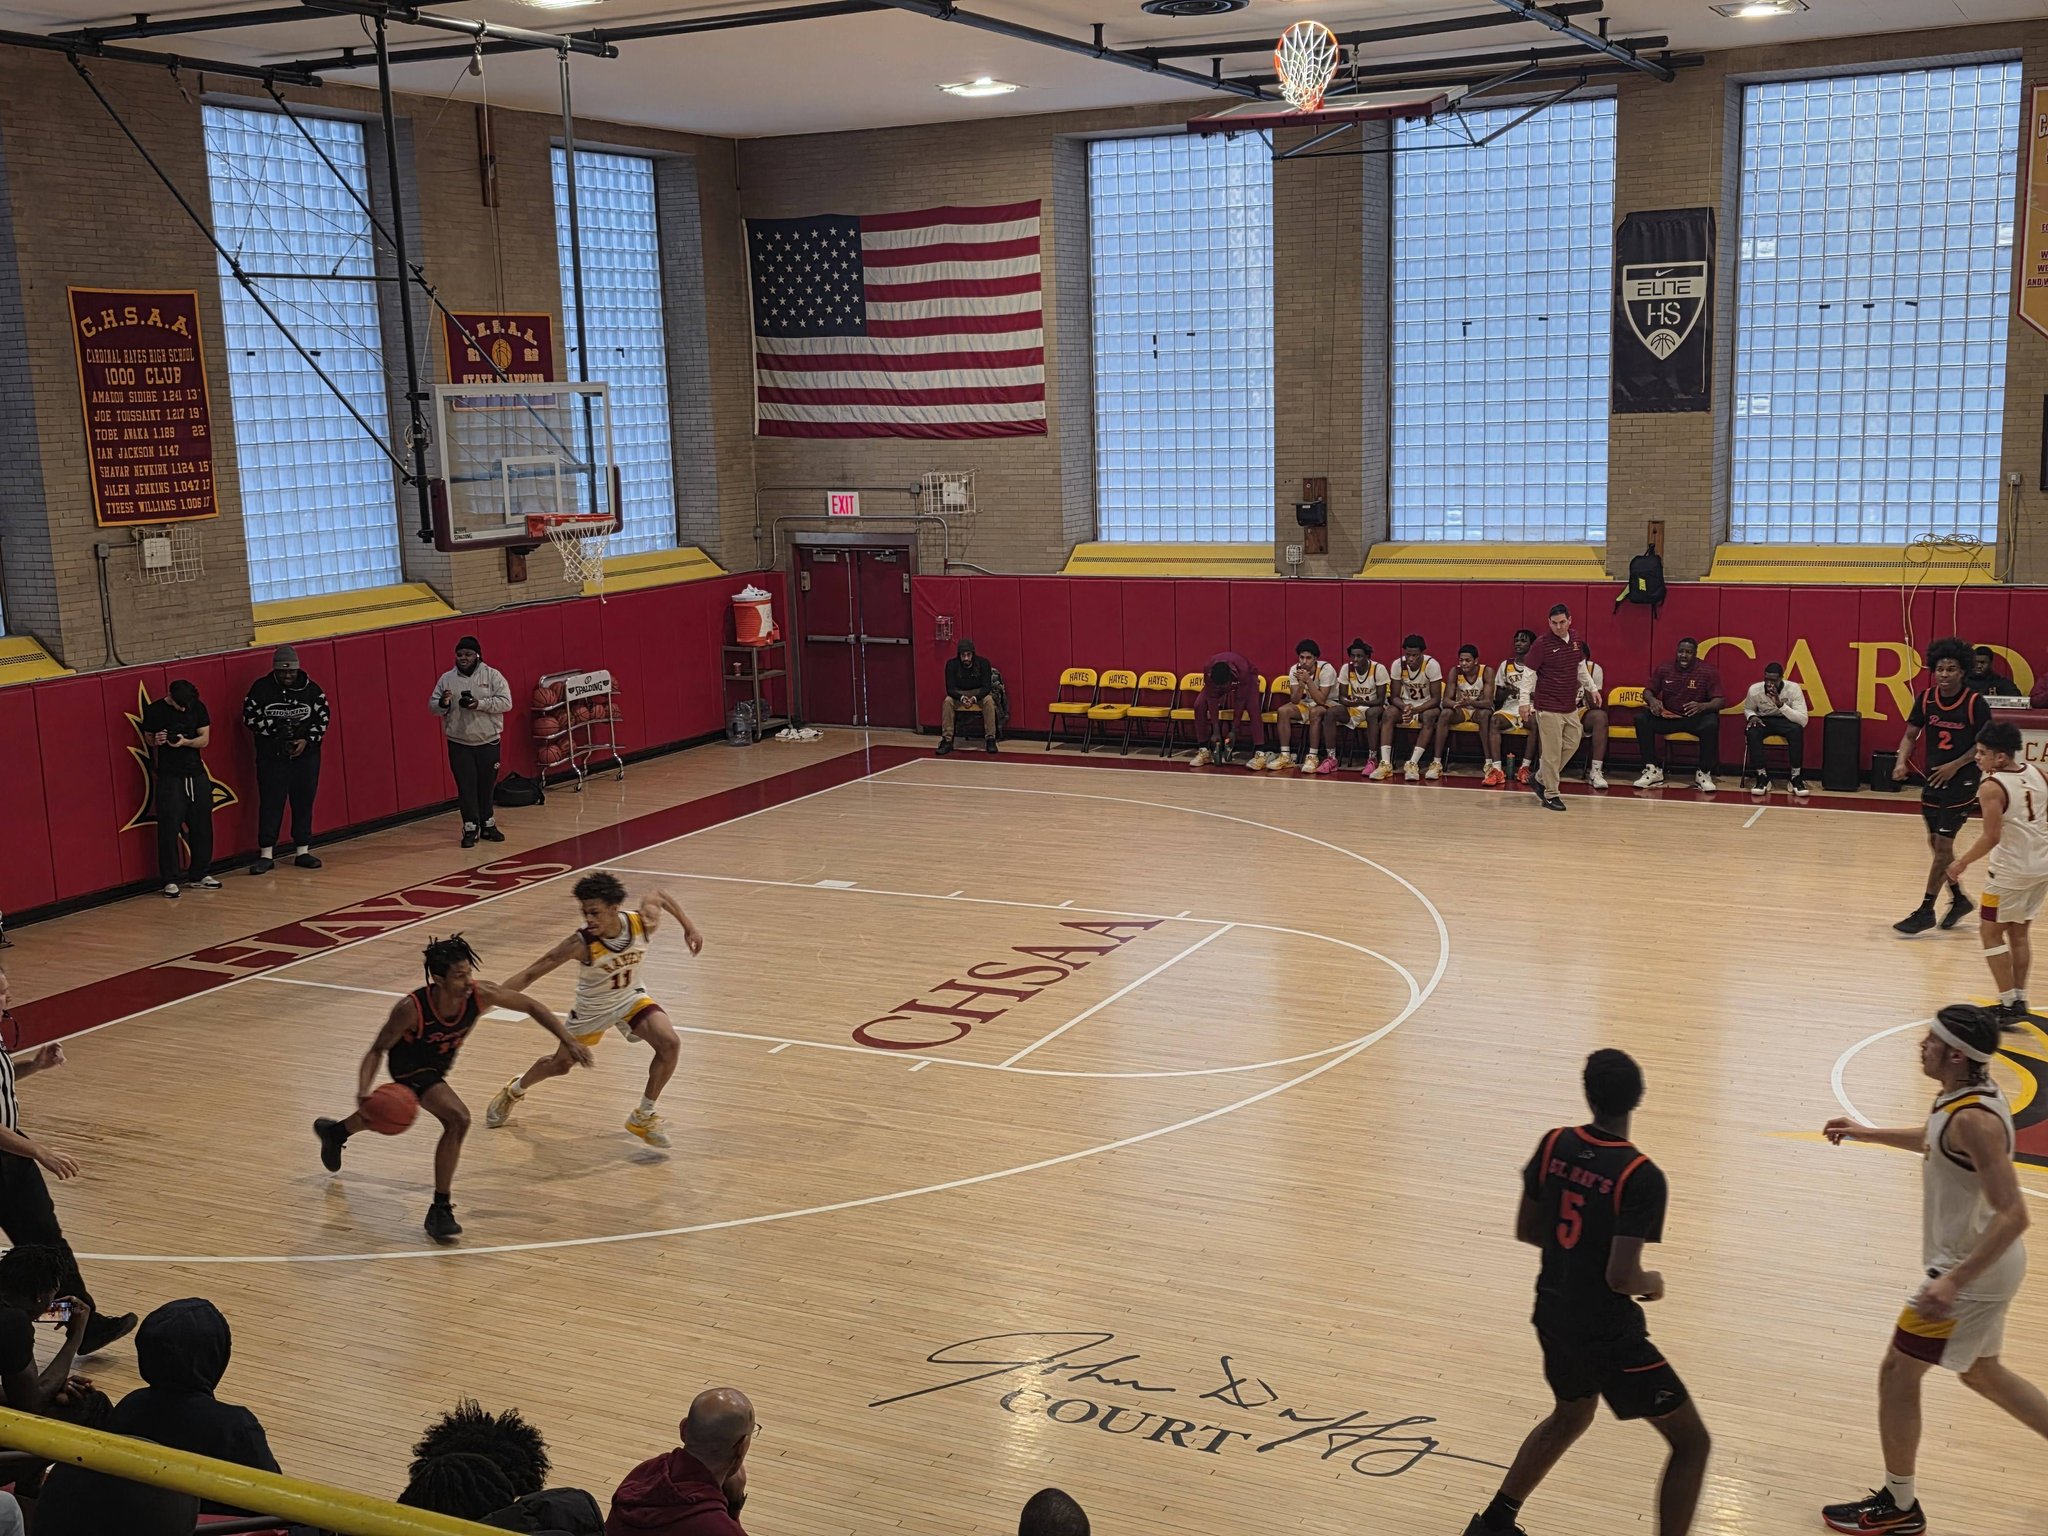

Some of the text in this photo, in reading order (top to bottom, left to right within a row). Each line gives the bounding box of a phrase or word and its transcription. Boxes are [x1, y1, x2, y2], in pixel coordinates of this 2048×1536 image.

[1637, 280, 1691, 296] ELITE
[2027, 278, 2043, 287] AND
[1647, 301, 1681, 325] HS
[80, 306, 191, 339] C.H.S.A.A.
[86, 347, 195, 363] CARDINAL HAYES HIGH SCHOOL
[105, 367, 181, 385] 1000 CLUB
[463, 374, 493, 384] STATE
[92, 391, 124, 403] AMADOU
[128, 390, 158, 402] SIDIBE
[94, 410, 112, 422] JOE
[116, 409, 161, 422] TOUSSAINT
[95, 429, 118, 441] TOBE
[97, 447, 113, 459] IAN
[118, 446, 155, 459] JACKSON
[99, 465, 129, 478] SHAVAR
[134, 463, 168, 477] NEWKIRK
[135, 482, 170, 495] JENKINS
[106, 502, 135, 515] TYRESE
[138, 499, 177, 513] WILLIAMS
[831, 495, 855, 515] EXIT
[1069, 671, 1089, 683] HAYES
[1108, 673, 1129, 686] HAYES
[1147, 676, 1168, 687] HAYES
[1189, 677, 1204, 688] HAY
[575, 680, 603, 696] SPALDING
[1410, 688, 1425, 700] 21
[1619, 691, 1645, 703] HAYES
[1938, 730, 1954, 750] 2
[2024, 790, 2036, 822] 1
[148, 860, 572, 980] HAYES
[851, 919, 1165, 1050] CHSAA
[1556, 1189, 1586, 1250] 5
[1000, 1391, 1252, 1455] COURT
